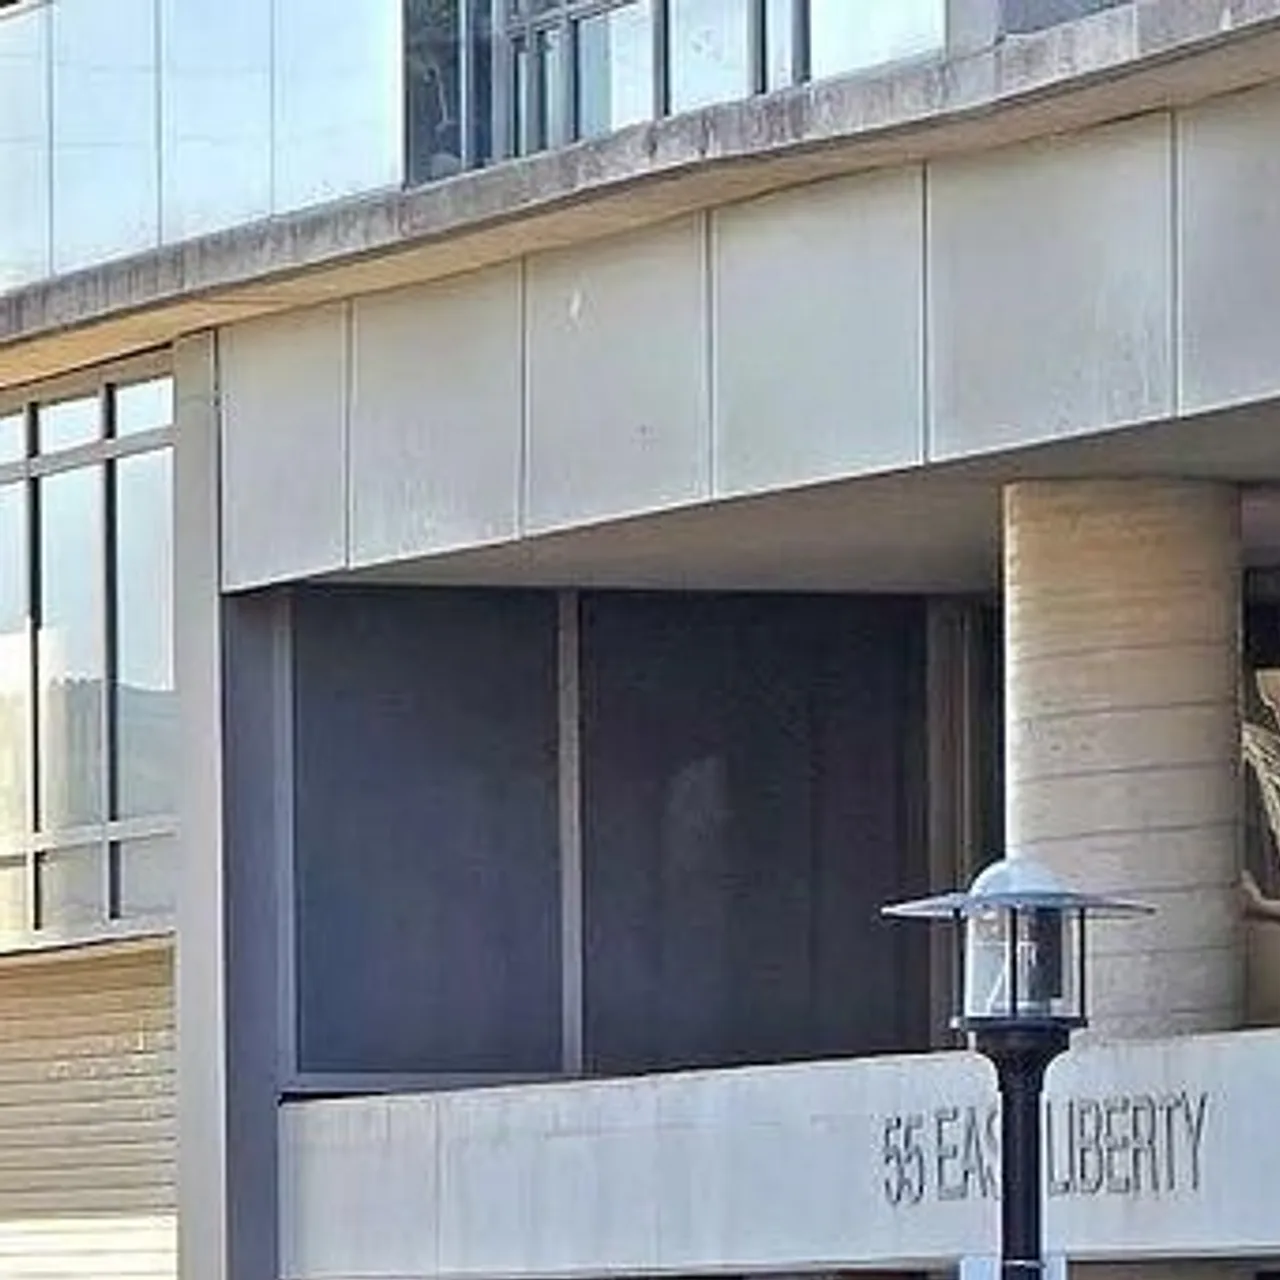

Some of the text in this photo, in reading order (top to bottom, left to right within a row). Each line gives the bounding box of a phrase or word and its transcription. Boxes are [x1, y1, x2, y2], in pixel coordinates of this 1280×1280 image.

[883, 1092, 1207, 1204] 55 EAS LIBERTY
